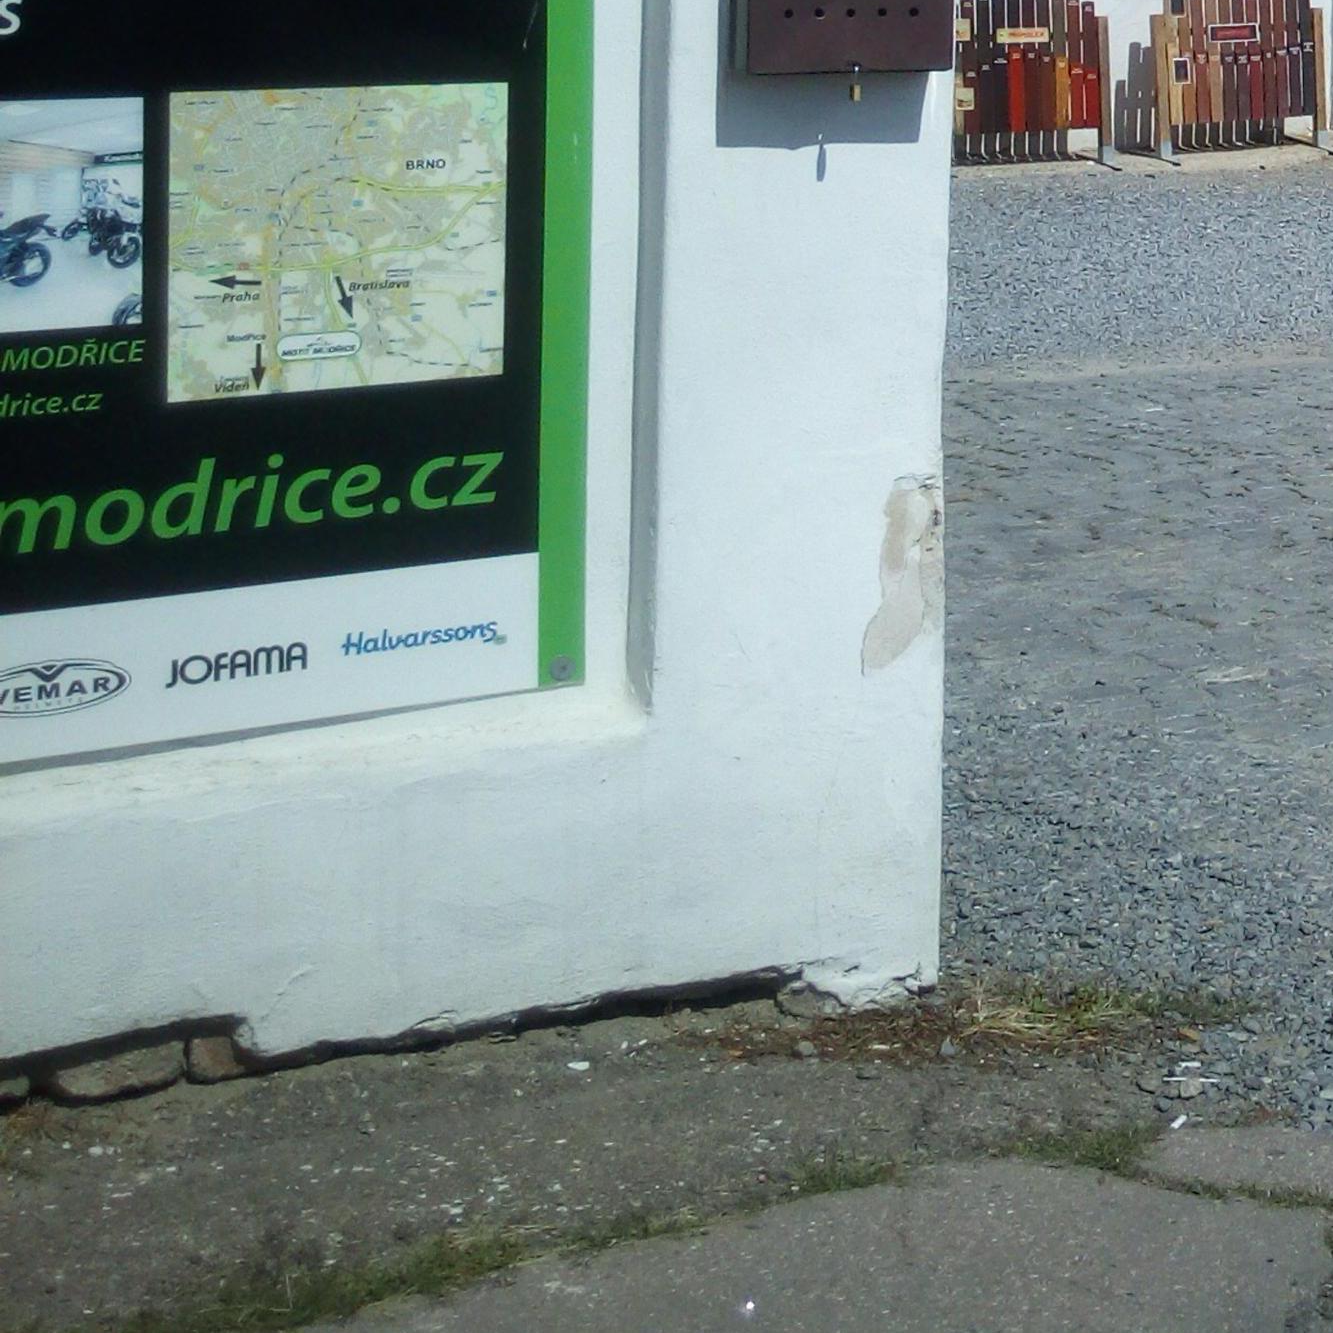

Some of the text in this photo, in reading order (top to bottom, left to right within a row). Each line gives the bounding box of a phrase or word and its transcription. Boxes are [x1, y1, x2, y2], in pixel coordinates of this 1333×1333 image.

[405, 159, 446, 170] BRNO
[222, 291, 260, 303] Praha
[349, 279, 411, 292] Bratislava
[1, 338, 146, 372] MODŘICE
[341, 621, 498, 656] Halvarssons
[165, 641, 308, 688] JOFAMA
